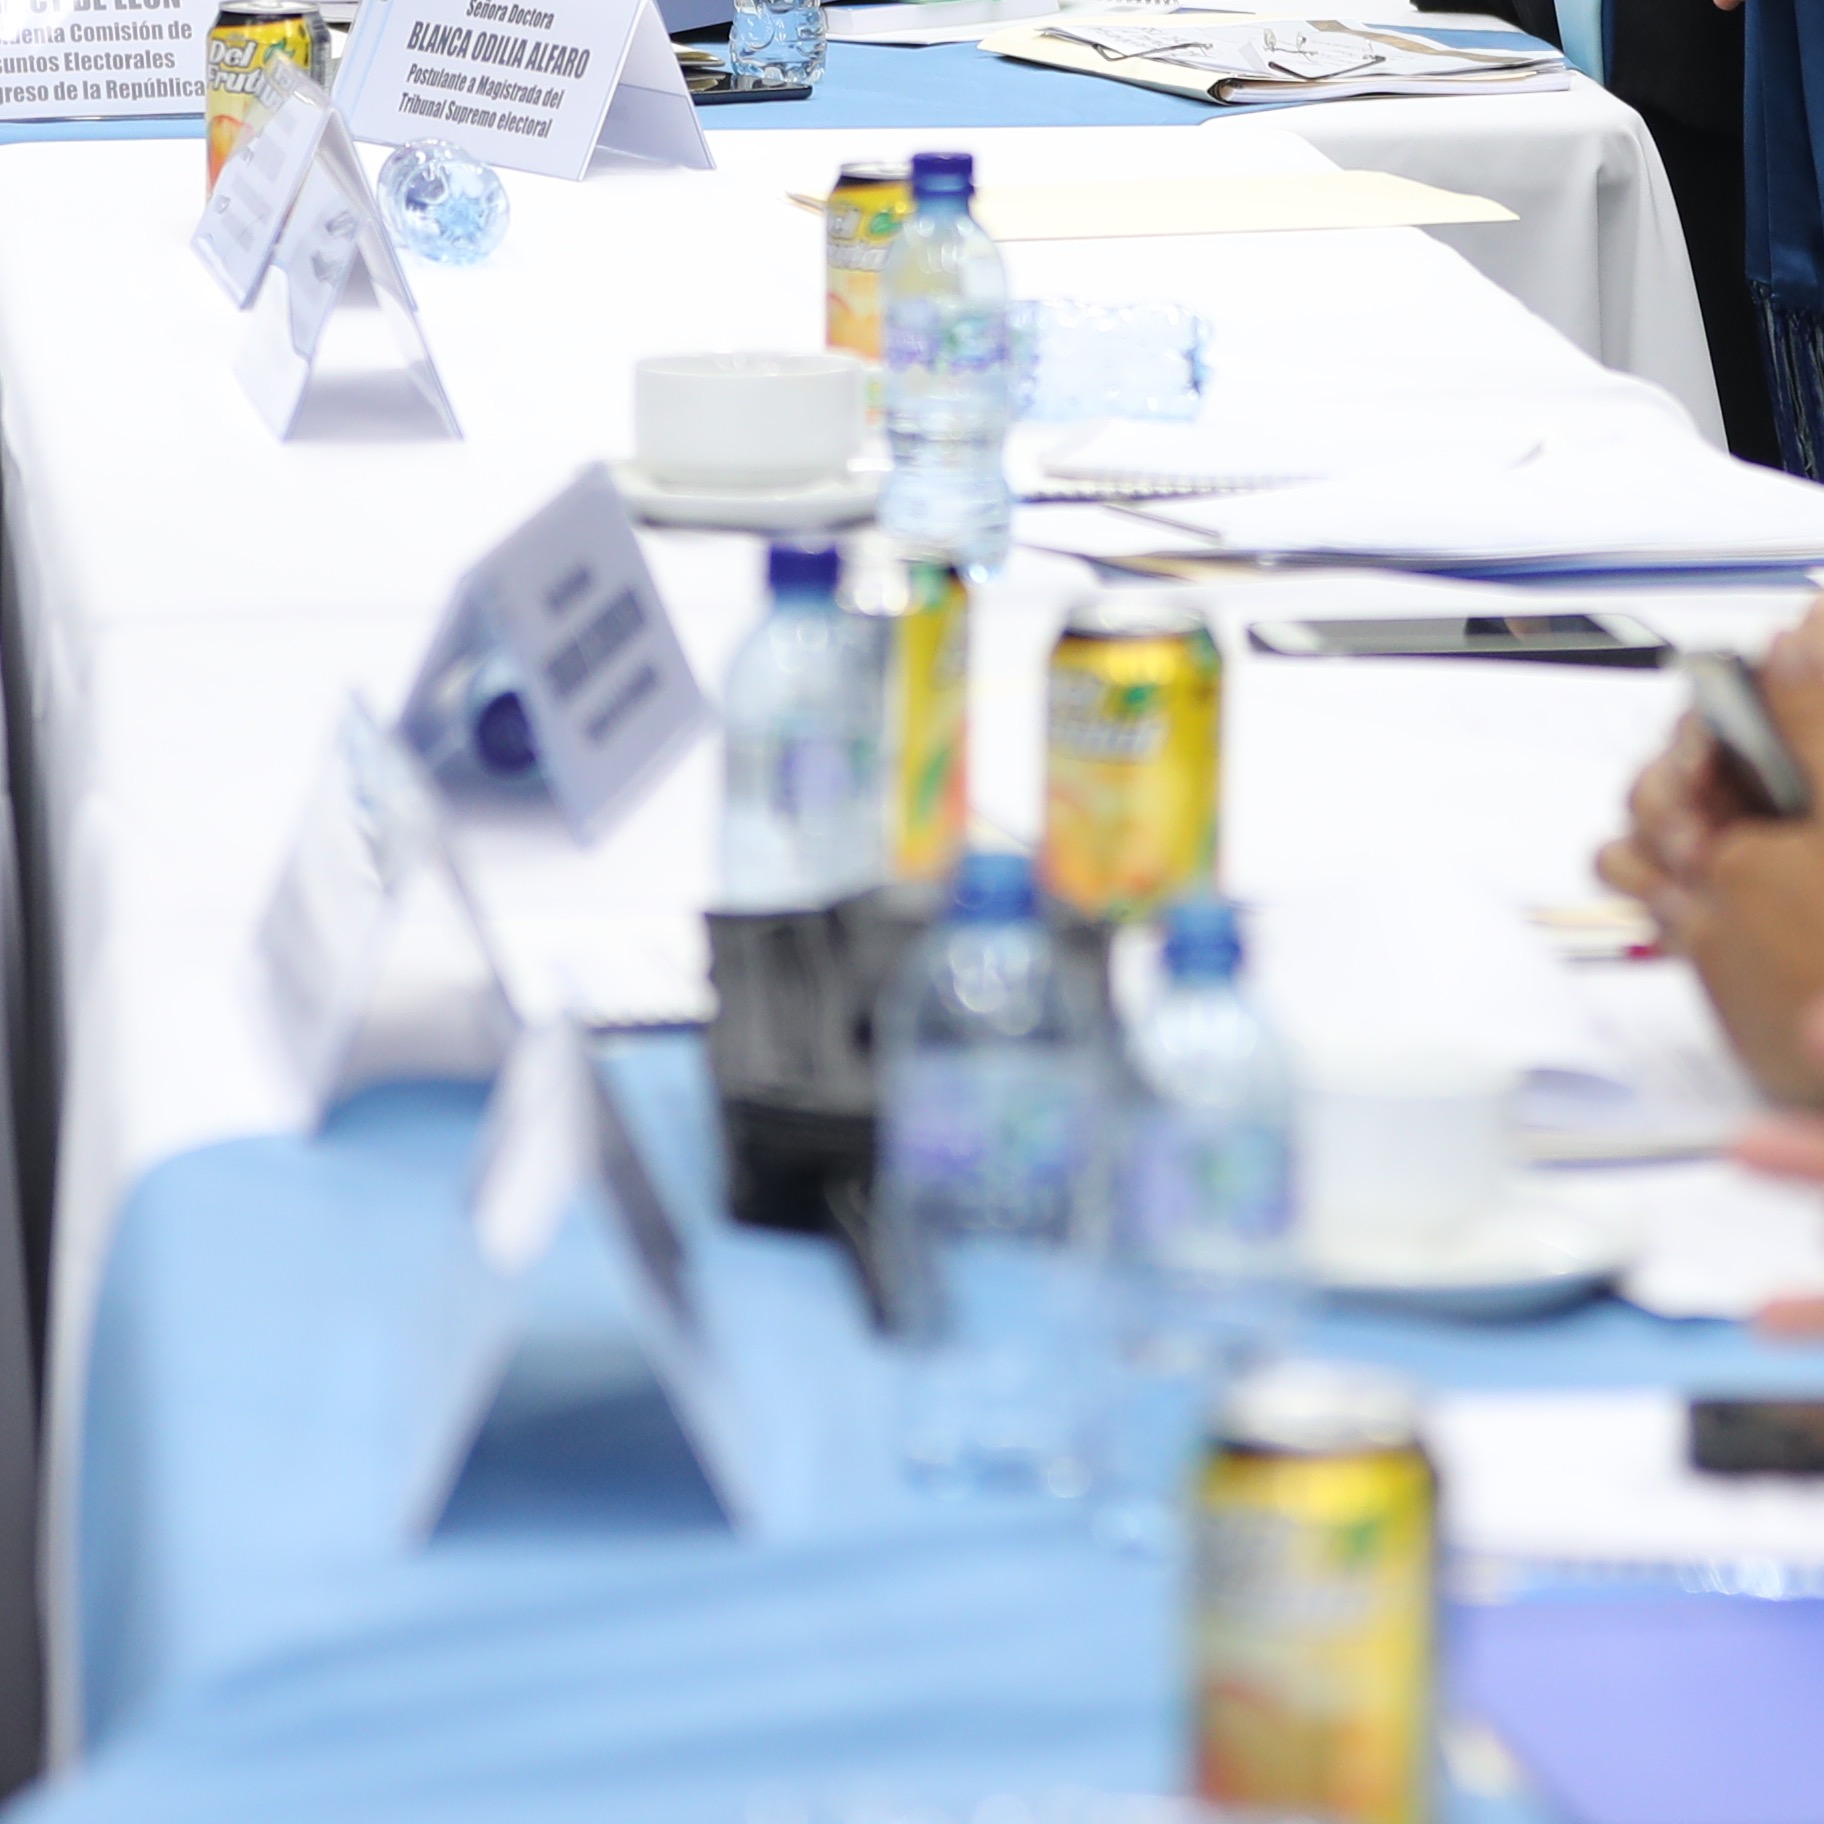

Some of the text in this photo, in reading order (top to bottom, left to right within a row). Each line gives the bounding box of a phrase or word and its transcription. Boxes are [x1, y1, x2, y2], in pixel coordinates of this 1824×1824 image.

[507, 4, 554, 30] Doctora
[70, 21, 164, 43] Comisión
[167, 20, 192, 40] de
[64, 50, 175, 72] Electorales
[208, 39, 257, 67] Del
[406, 21, 591, 80] BLANCA ODILIA ALFARO
[53, 81, 79, 101] de
[82, 80, 102, 100] la
[105, 77, 205, 102] República
[406, 63, 565, 110] Postulante a Magistrada del
[398, 92, 553, 139] Tribunal Supremo electoral
